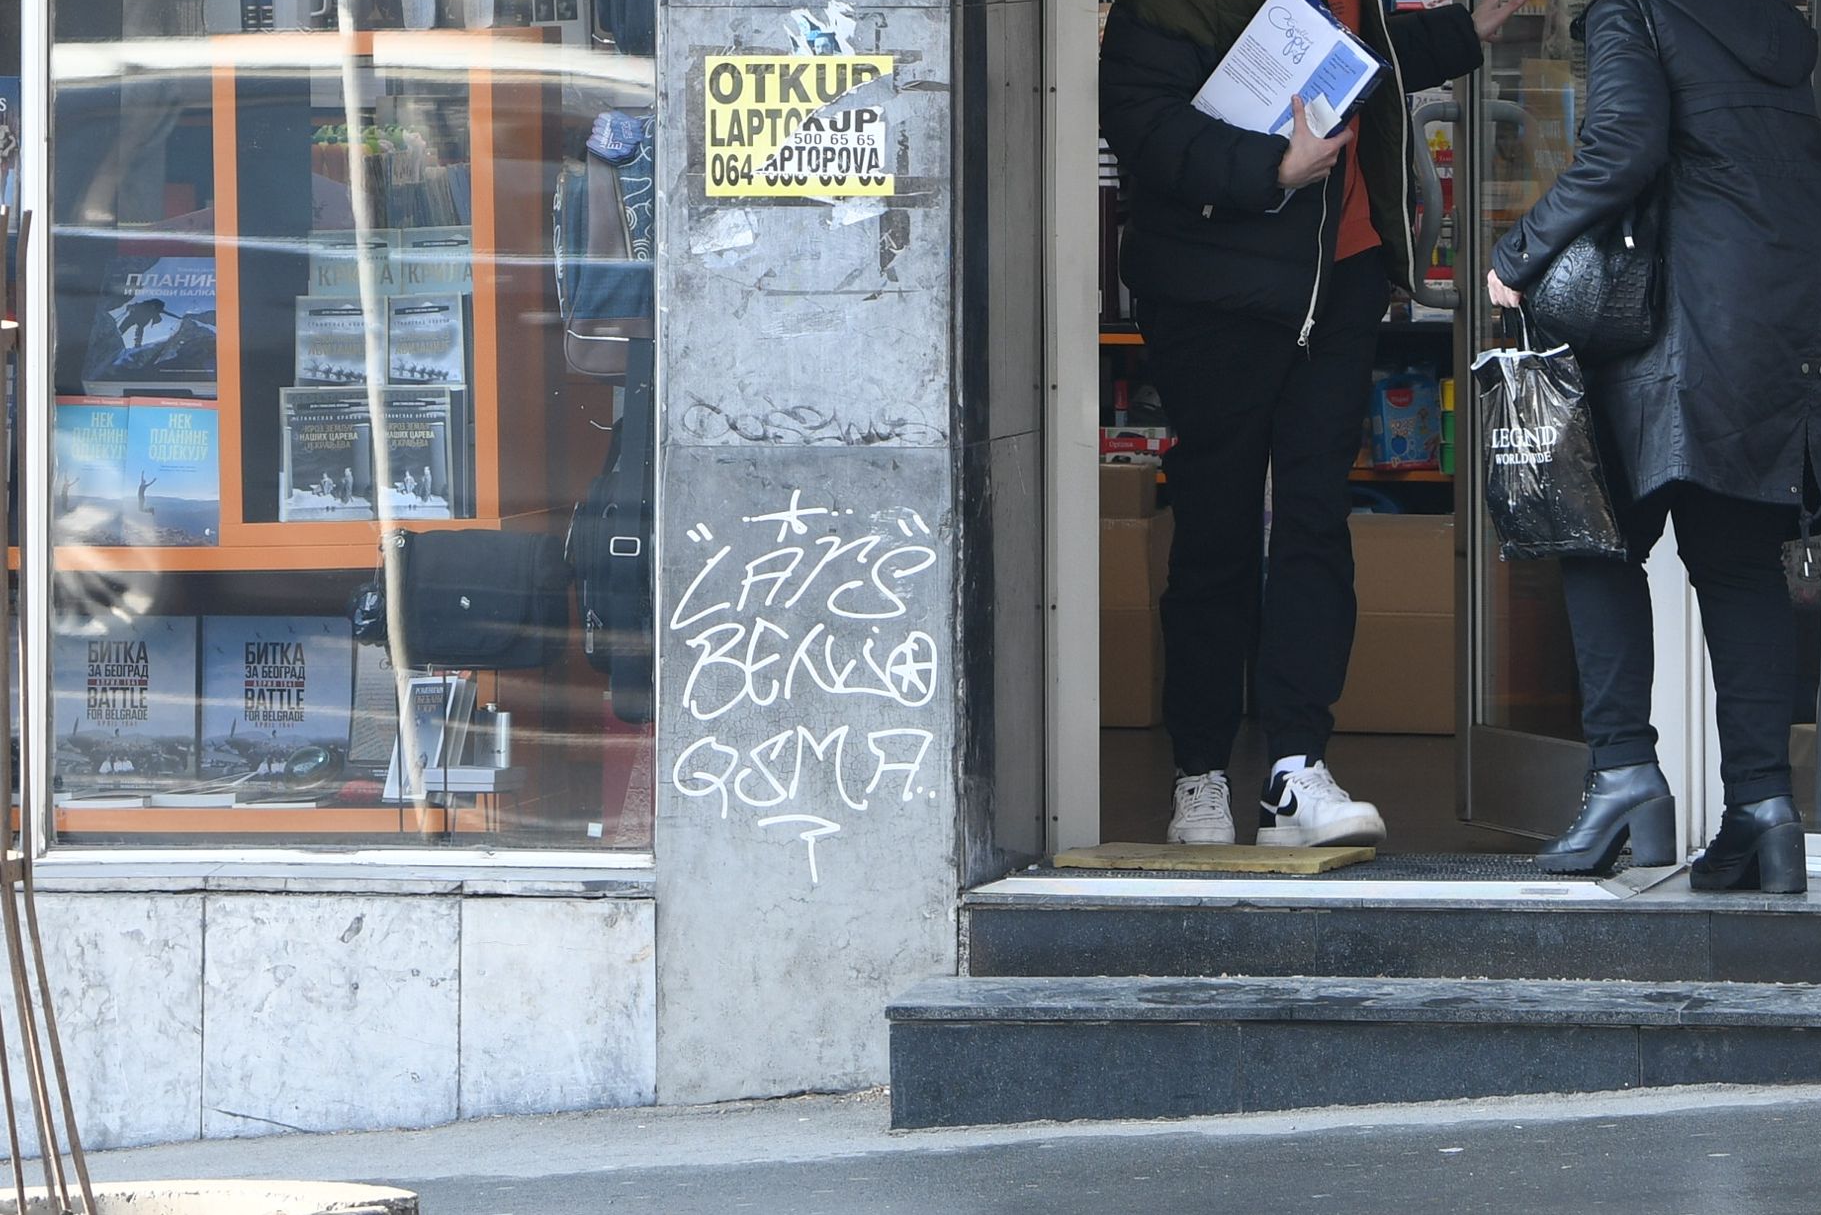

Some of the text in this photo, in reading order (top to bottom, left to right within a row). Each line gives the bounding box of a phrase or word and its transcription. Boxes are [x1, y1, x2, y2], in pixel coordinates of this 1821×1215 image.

[830, 133, 848, 145] 65
[857, 134, 875, 146] 65
[169, 413, 192, 429] НЕК
[151, 430, 208, 446] ПЛАНИНЕ
[87, 640, 149, 664] БИТКА
[245, 642, 305, 665] БИТКА
[88, 664, 149, 679] ЗА БЕОГРАД
[245, 666, 306, 681] ЗА БЕОГРАД
[88, 686, 148, 709] BATTLE
[245, 688, 305, 711] BATTLE
[87, 708, 148, 721] FOR BELGRADE
[245, 710, 305, 722] FOR BELGRADE
